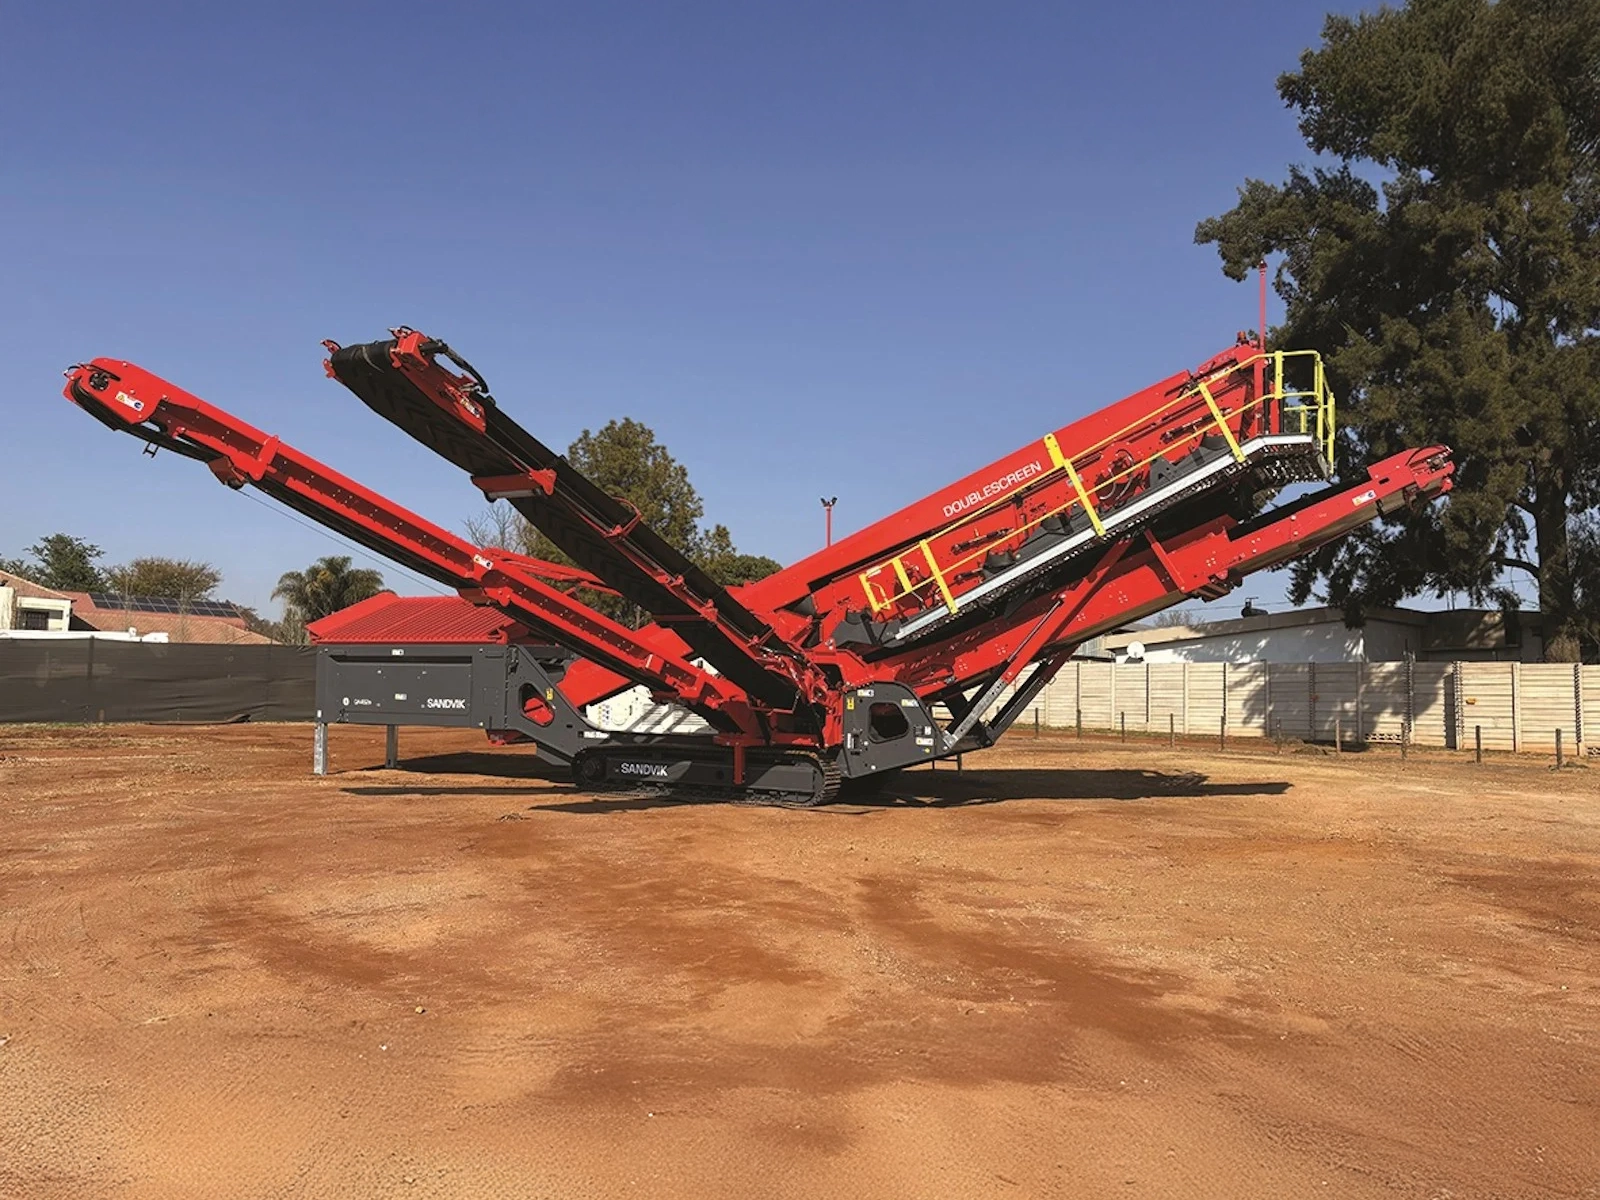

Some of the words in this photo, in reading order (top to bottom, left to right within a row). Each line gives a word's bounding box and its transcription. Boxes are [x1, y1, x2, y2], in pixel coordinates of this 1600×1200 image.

[942, 460, 1042, 517] DOUBLESCREEN
[427, 698, 466, 709] SANDVIK
[621, 762, 668, 776] SANDVIK
